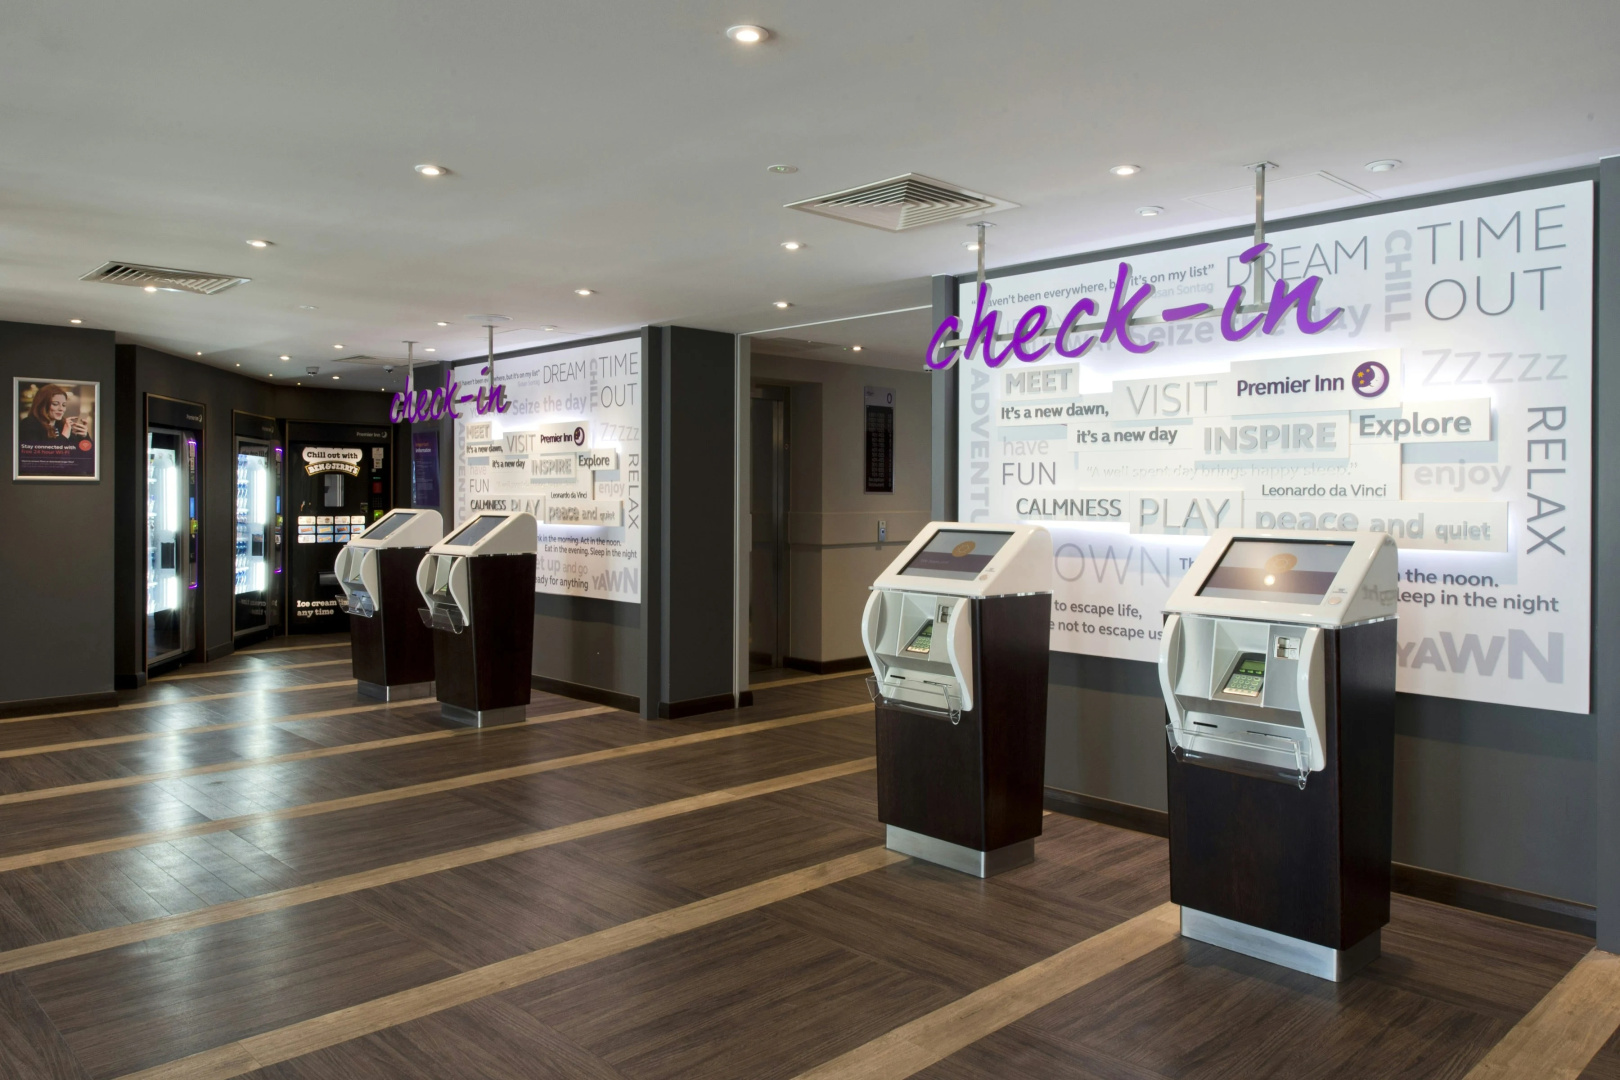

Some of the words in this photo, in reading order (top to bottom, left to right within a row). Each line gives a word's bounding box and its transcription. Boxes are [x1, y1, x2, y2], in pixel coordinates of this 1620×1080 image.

[1417, 204, 1567, 265] TIME
[1227, 235, 1367, 288] DREAM
[988, 293, 1016, 307] aven't
[1017, 291, 1042, 303] been
[1043, 281, 1107, 299] everywhere,
[1150, 272, 1165, 283] on
[1168, 269, 1187, 282] my
[1176, 282, 1214, 295] Sontag
[1384, 229, 1412, 332] CHILL
[1424, 265, 1562, 321] OUT
[925, 242, 1345, 370] check-in
[543, 360, 586, 384] DREAM
[599, 351, 639, 379] TIME
[589, 357, 598, 412] CHILL
[1005, 368, 1073, 395] MEET
[1237, 378, 1311, 396] Premier
[1314, 374, 1345, 392] Inn
[389, 366, 512, 424] check-in
[512, 396, 540, 416] Seize
[543, 395, 562, 412] the
[565, 393, 587, 415] day
[600, 383, 638, 408] OUT
[1126, 380, 1218, 416] VISIT
[1023, 409, 1032, 419] a
[1034, 406, 1063, 419] new
[1066, 402, 1109, 418] dawn,
[466, 424, 490, 439] MEET
[1101, 431, 1111, 442] a
[1113, 430, 1145, 443] new
[1149, 426, 1178, 444] day
[1359, 411, 1472, 440] Explore
[506, 433, 536, 453] VISIT
[540, 433, 563, 444] Premier
[563, 432, 573, 442] Inn
[970, 367, 990, 523] ADVENTU
[1002, 436, 1049, 456] have
[1203, 422, 1337, 455] INSPIRE
[306, 451, 326, 459] Chill
[504, 460, 515, 468] new
[515, 459, 526, 470] day
[578, 455, 610, 469] Explore
[469, 464, 487, 476] have
[531, 458, 572, 476] INSPIRE
[1002, 461, 1057, 486] FUN
[1173, 464, 1197, 480] day
[1251, 463, 1299, 480] happy
[1414, 459, 1512, 493] enjoy
[469, 478, 490, 493] FUN
[598, 480, 625, 497] enjoy
[1261, 484, 1326, 497] Leonardo
[1329, 484, 1347, 497] da
[1350, 484, 1387, 497] Vinci
[1526, 406, 1567, 555] RELAX
[550, 491, 570, 499] Leonardo
[570, 491, 577, 499] da
[577, 491, 588, 499] Vinci
[628, 453, 640, 530] RELAX
[470, 499, 507, 511] CALMNESS
[548, 506, 580, 522] peace
[581, 507, 598, 520] and
[599, 510, 615, 523] quiet
[1016, 497, 1122, 517] CALMNESS
[1139, 498, 1230, 529] PLAY
[1255, 511, 1359, 531] peace
[1369, 513, 1425, 539] and
[1434, 521, 1490, 544] quiet
[596, 537, 605, 545] the
[545, 544, 553, 552] Eat
[553, 545, 558, 553] in
[558, 545, 567, 553] the
[590, 548, 605, 558] Sleep
[605, 548, 611, 556] in
[612, 549, 621, 558] the
[621, 549, 637, 560] night
[547, 559, 561, 576] up
[562, 562, 577, 574] and
[577, 567, 589, 577] go
[1405, 568, 1438, 584] the
[1442, 573, 1499, 588] noon.
[535, 575, 548, 587] eady
[549, 575, 558, 585] for
[560, 577, 589, 592] anything
[592, 567, 639, 594] YAWN
[296, 600, 311, 608] Ice
[311, 599, 337, 608] cream
[296, 609, 314, 618] any
[314, 607, 334, 616] time
[1053, 599, 1067, 611] to
[1070, 602, 1114, 617] escape
[1117, 603, 1142, 620] life,
[1398, 590, 1436, 607] leep
[1440, 590, 1459, 607] in
[1463, 591, 1498, 608] the
[1503, 594, 1559, 615] night
[1058, 620, 1079, 632] not
[1082, 620, 1096, 633] to
[1098, 625, 1145, 640] escape
[1396, 629, 1564, 684] YAWN
